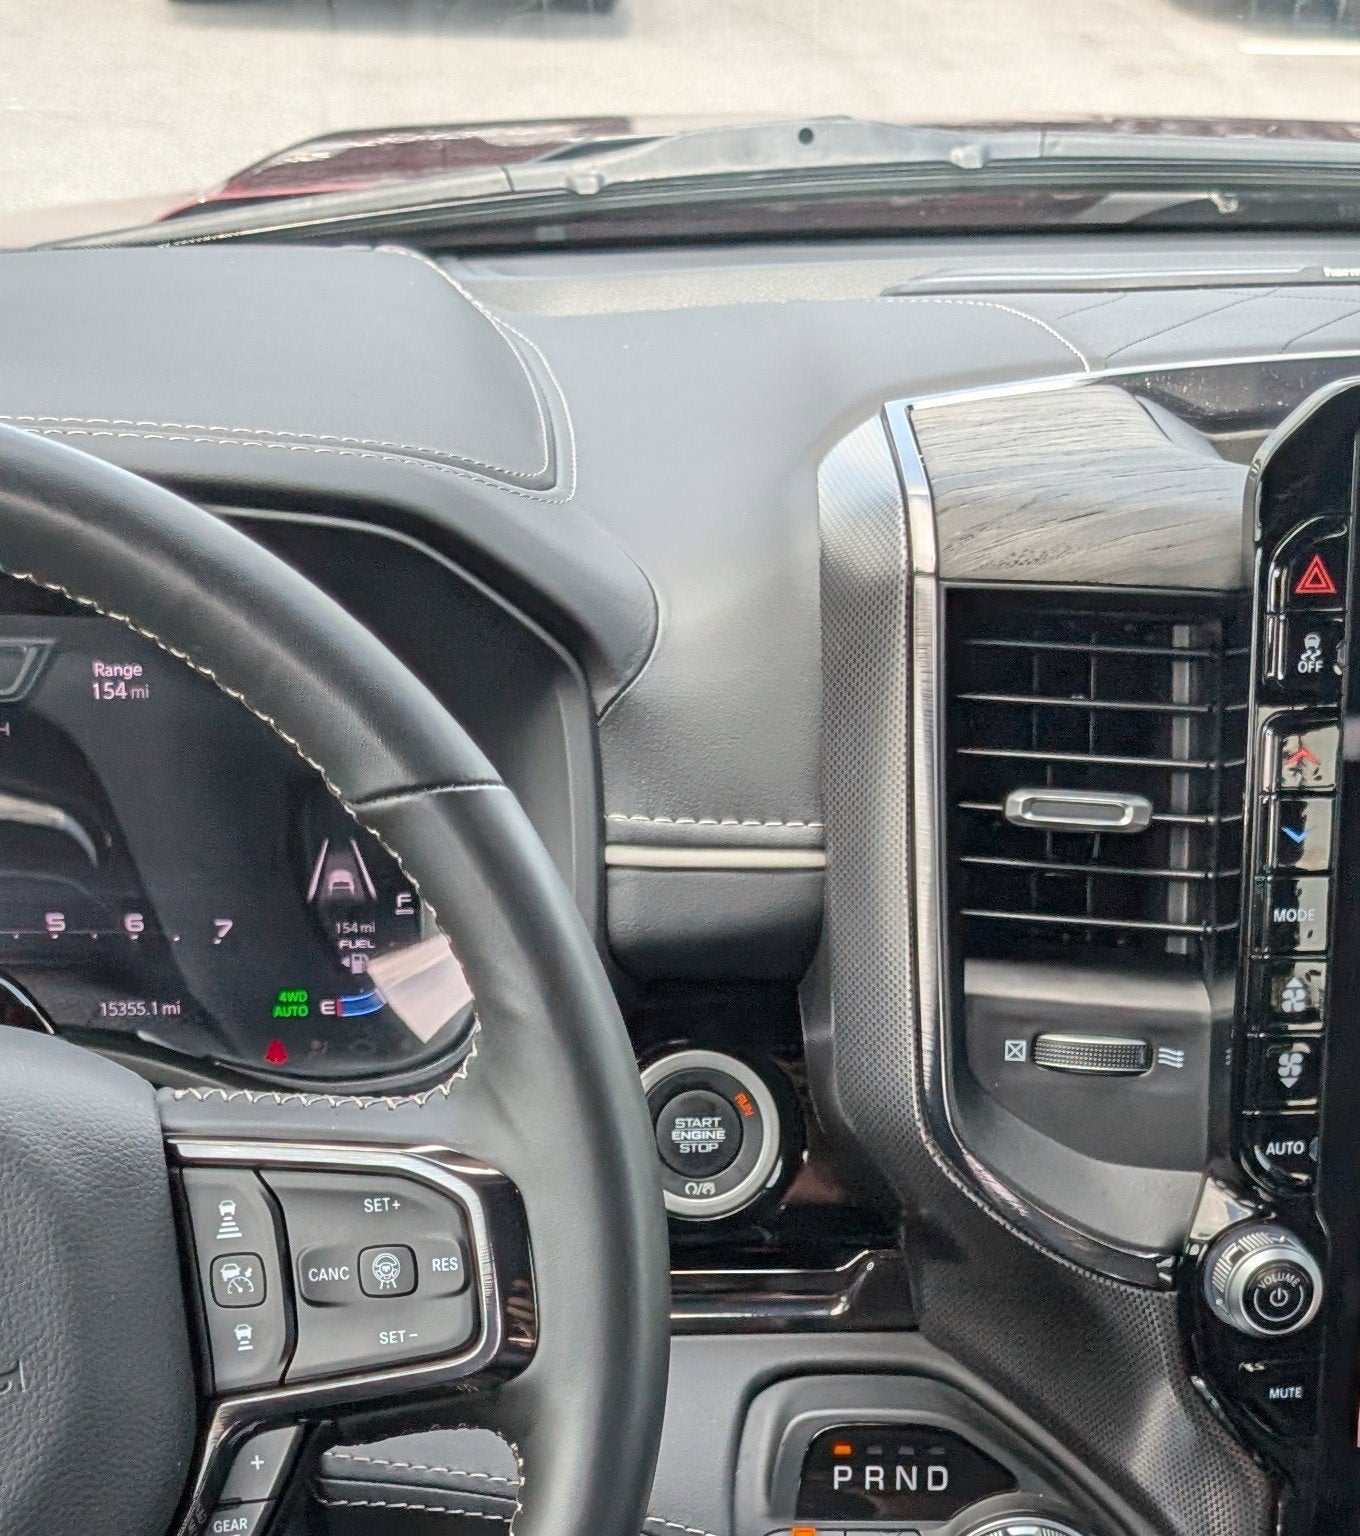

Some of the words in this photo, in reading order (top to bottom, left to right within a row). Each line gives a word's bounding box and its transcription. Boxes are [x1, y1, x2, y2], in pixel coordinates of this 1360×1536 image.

[93, 662, 144, 679] Range
[1298, 660, 1324, 674] OFF
[92, 682, 127, 699] 154
[130, 684, 150, 699] mi
[45, 913, 67, 932] 5
[124, 913, 145, 932] 6
[1273, 909, 1315, 923] MODE
[213, 919, 234, 938] 7
[336, 923, 357, 935] 154
[359, 922, 376, 935] mi
[340, 939, 376, 950] FUEL
[278, 989, 309, 1003] 4WD
[100, 1001, 159, 1017] 15355.1
[162, 1000, 181, 1016] mi
[273, 1004, 309, 1019] AUTO
[675, 1117, 722, 1129] START
[671, 1130, 726, 1141] ENGINE
[679, 1142, 719, 1153] STOP
[1265, 1141, 1305, 1157] AUTO
[432, 1257, 459, 1272] RES
[308, 1266, 350, 1283] CANC
[1257, 1272, 1302, 1290] VOLUME
[1269, 1386, 1303, 1399] MUTE
[832, 1465, 853, 1490] P
[864, 1465, 885, 1491] R
[895, 1466, 918, 1491] N
[927, 1465, 949, 1491] D
[213, 1517, 248, 1533] GEAR
